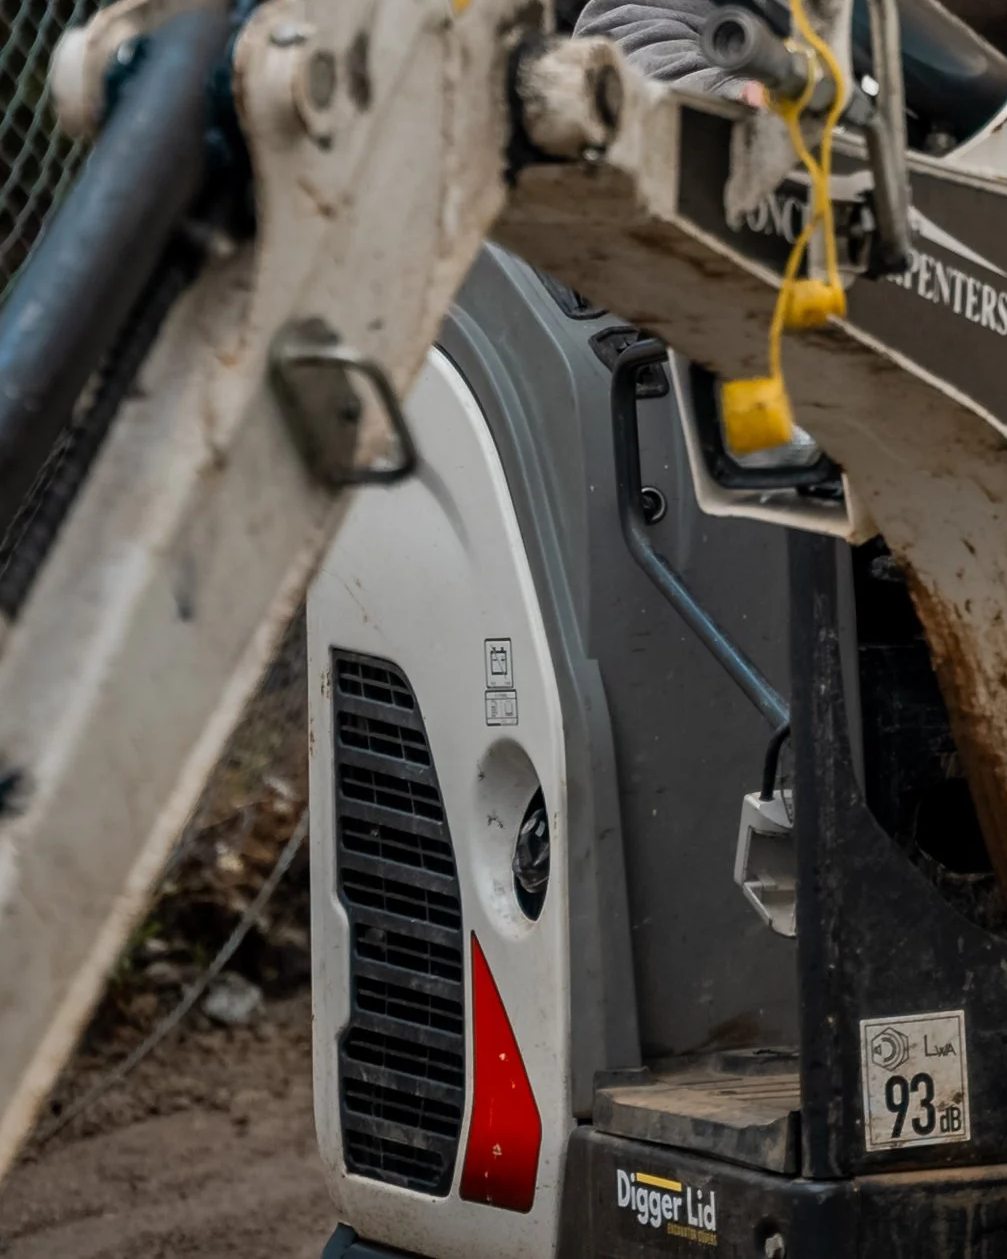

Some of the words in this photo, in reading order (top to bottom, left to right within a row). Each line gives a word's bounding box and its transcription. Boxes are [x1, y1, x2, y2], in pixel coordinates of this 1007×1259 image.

[885, 1072, 936, 1139] 93
[940, 1106, 962, 1133] dB
[617, 1169, 682, 1228] Digger
[687, 1186, 716, 1231] Lid
